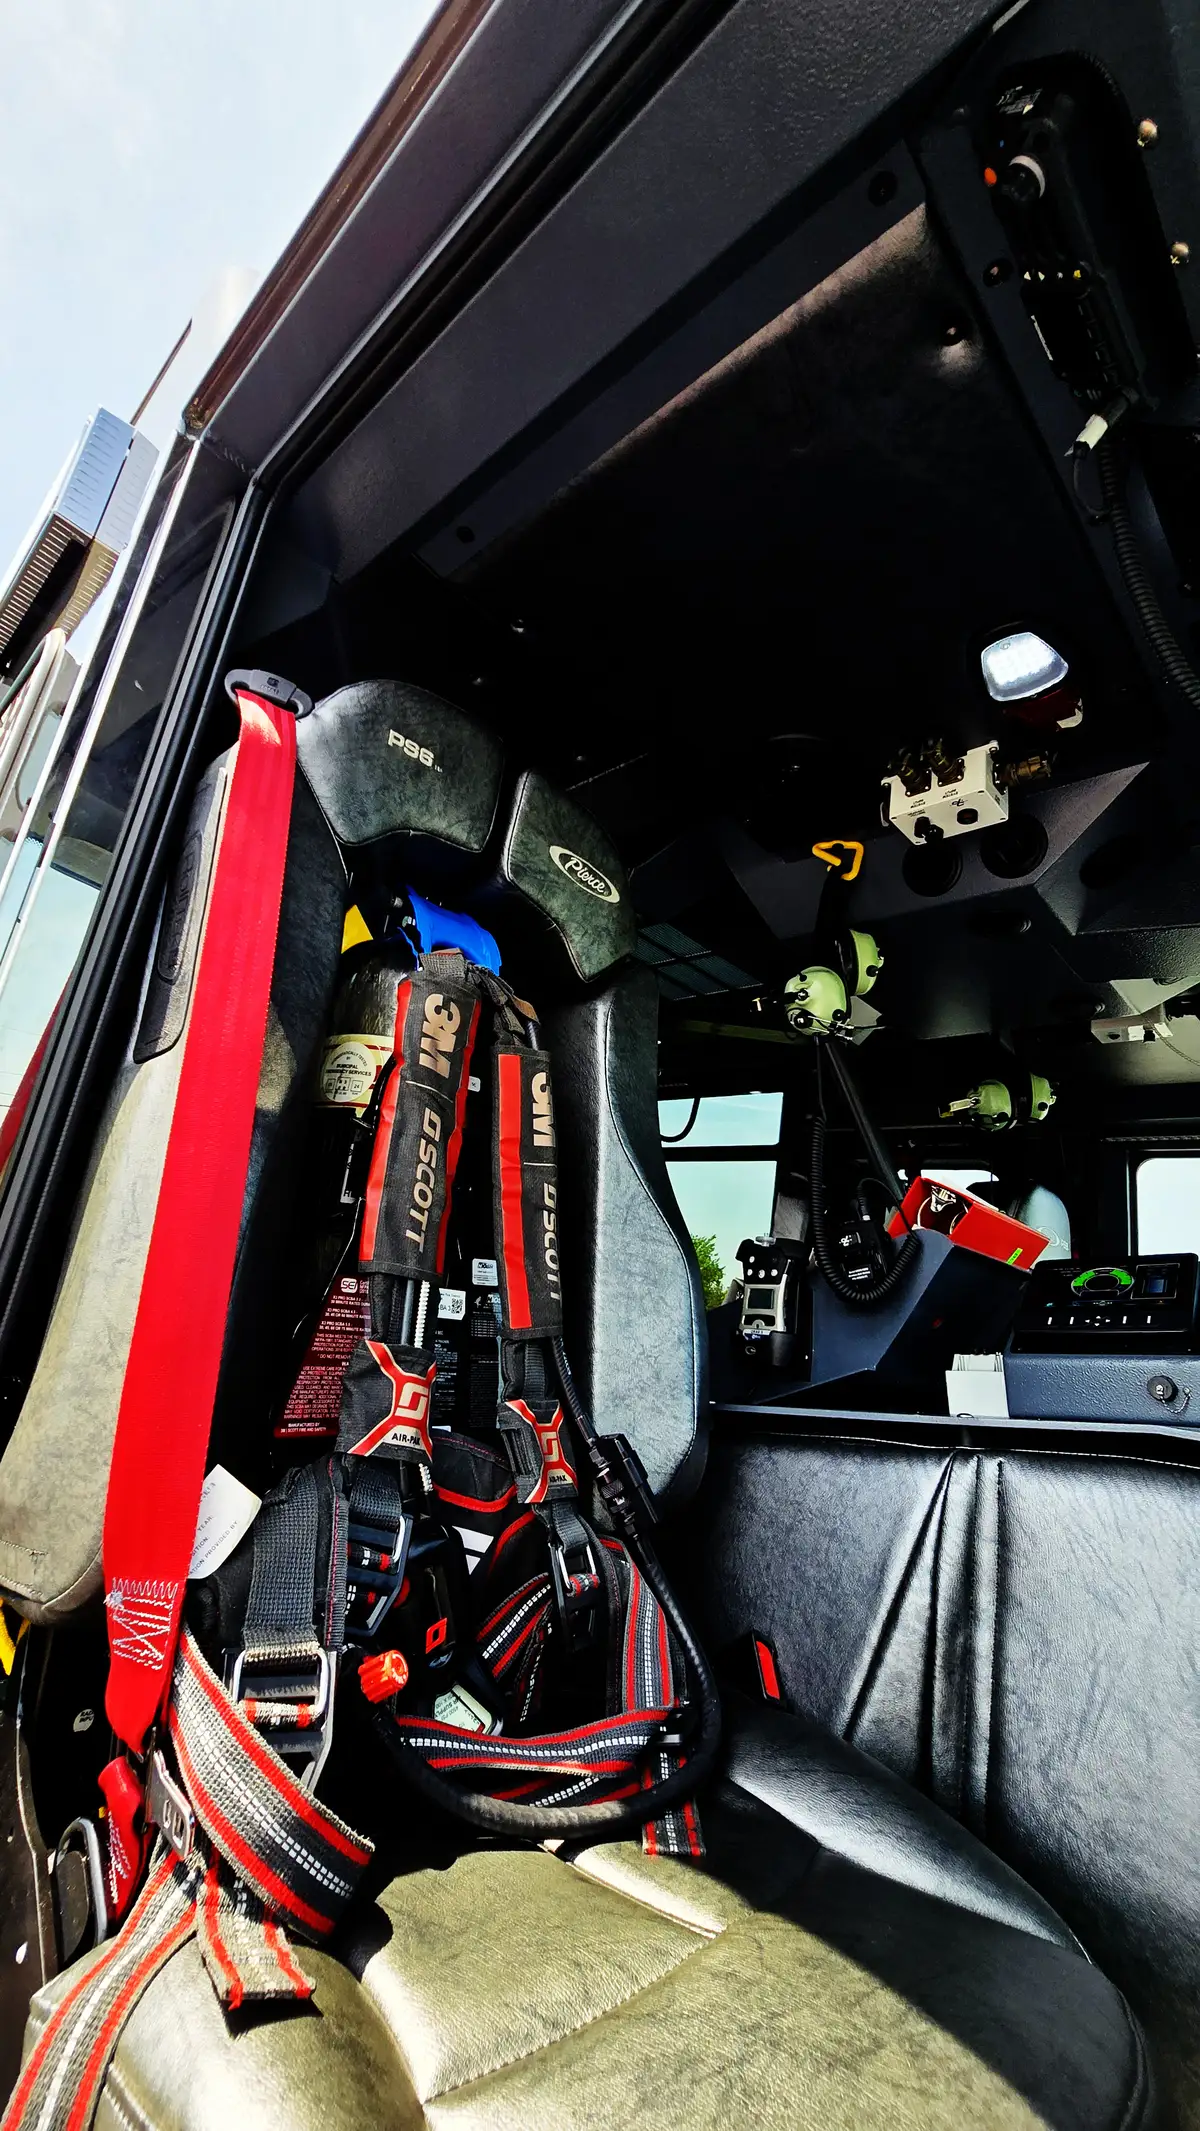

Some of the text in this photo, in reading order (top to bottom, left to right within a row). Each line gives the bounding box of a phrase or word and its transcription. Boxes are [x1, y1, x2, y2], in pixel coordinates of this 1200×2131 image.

[388, 729, 435, 768] PS6
[564, 857, 605, 893] Pierce
[419, 994, 460, 1078] 3M
[405, 1138, 438, 1253] SCOTT
[543, 1210, 561, 1307] SCOTT
[188, 1559, 205, 1575] ATION
[205, 1530, 230, 1558] PROVIDED
